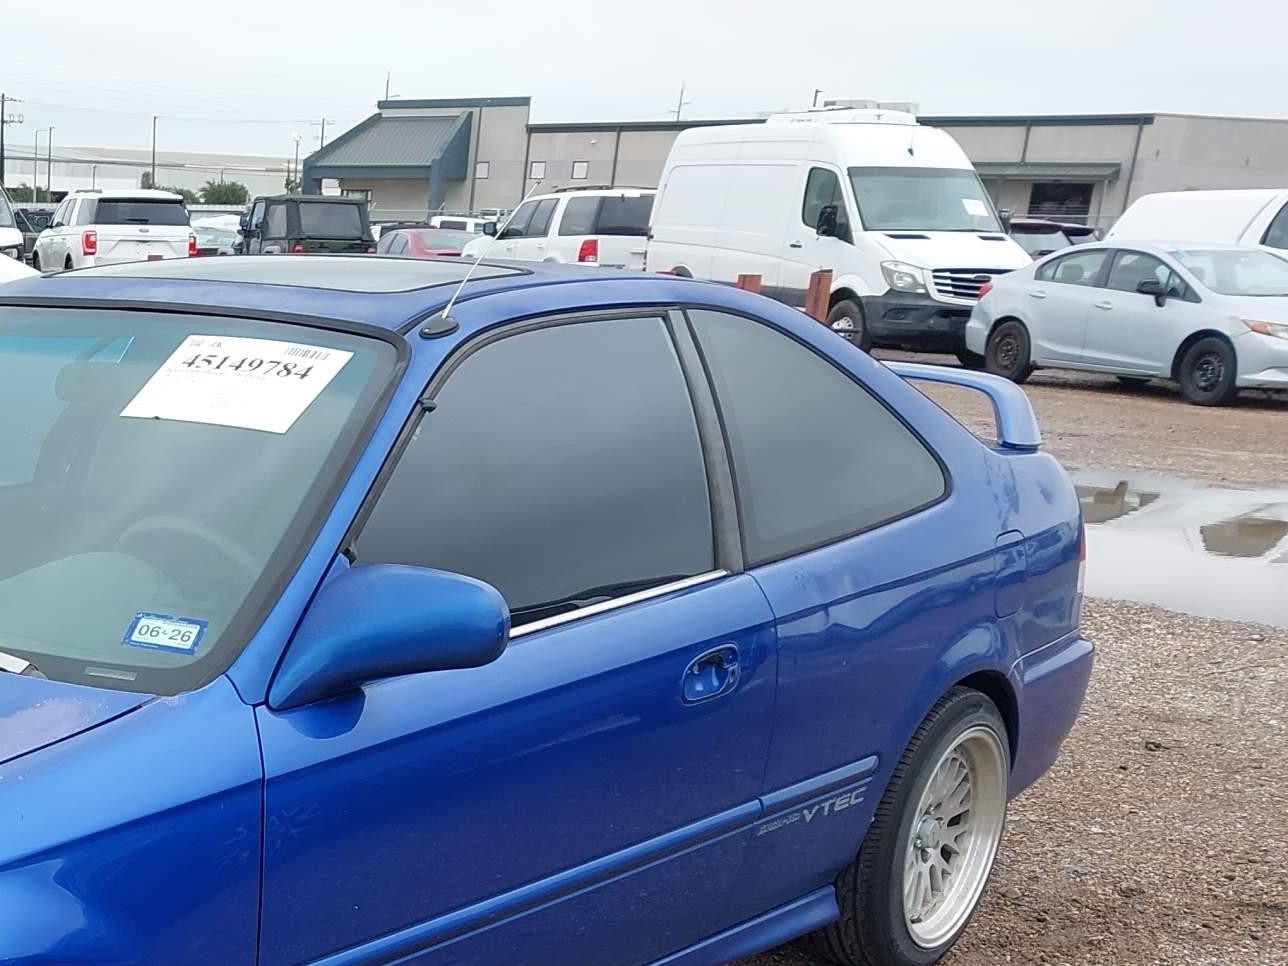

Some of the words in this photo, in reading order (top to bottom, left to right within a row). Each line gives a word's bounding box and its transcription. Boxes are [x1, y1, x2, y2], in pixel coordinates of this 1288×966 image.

[182, 353, 314, 380] 45149784
[138, 625, 161, 637] 06
[168, 629, 193, 642] 26
[802, 786, 867, 823] VTEC
